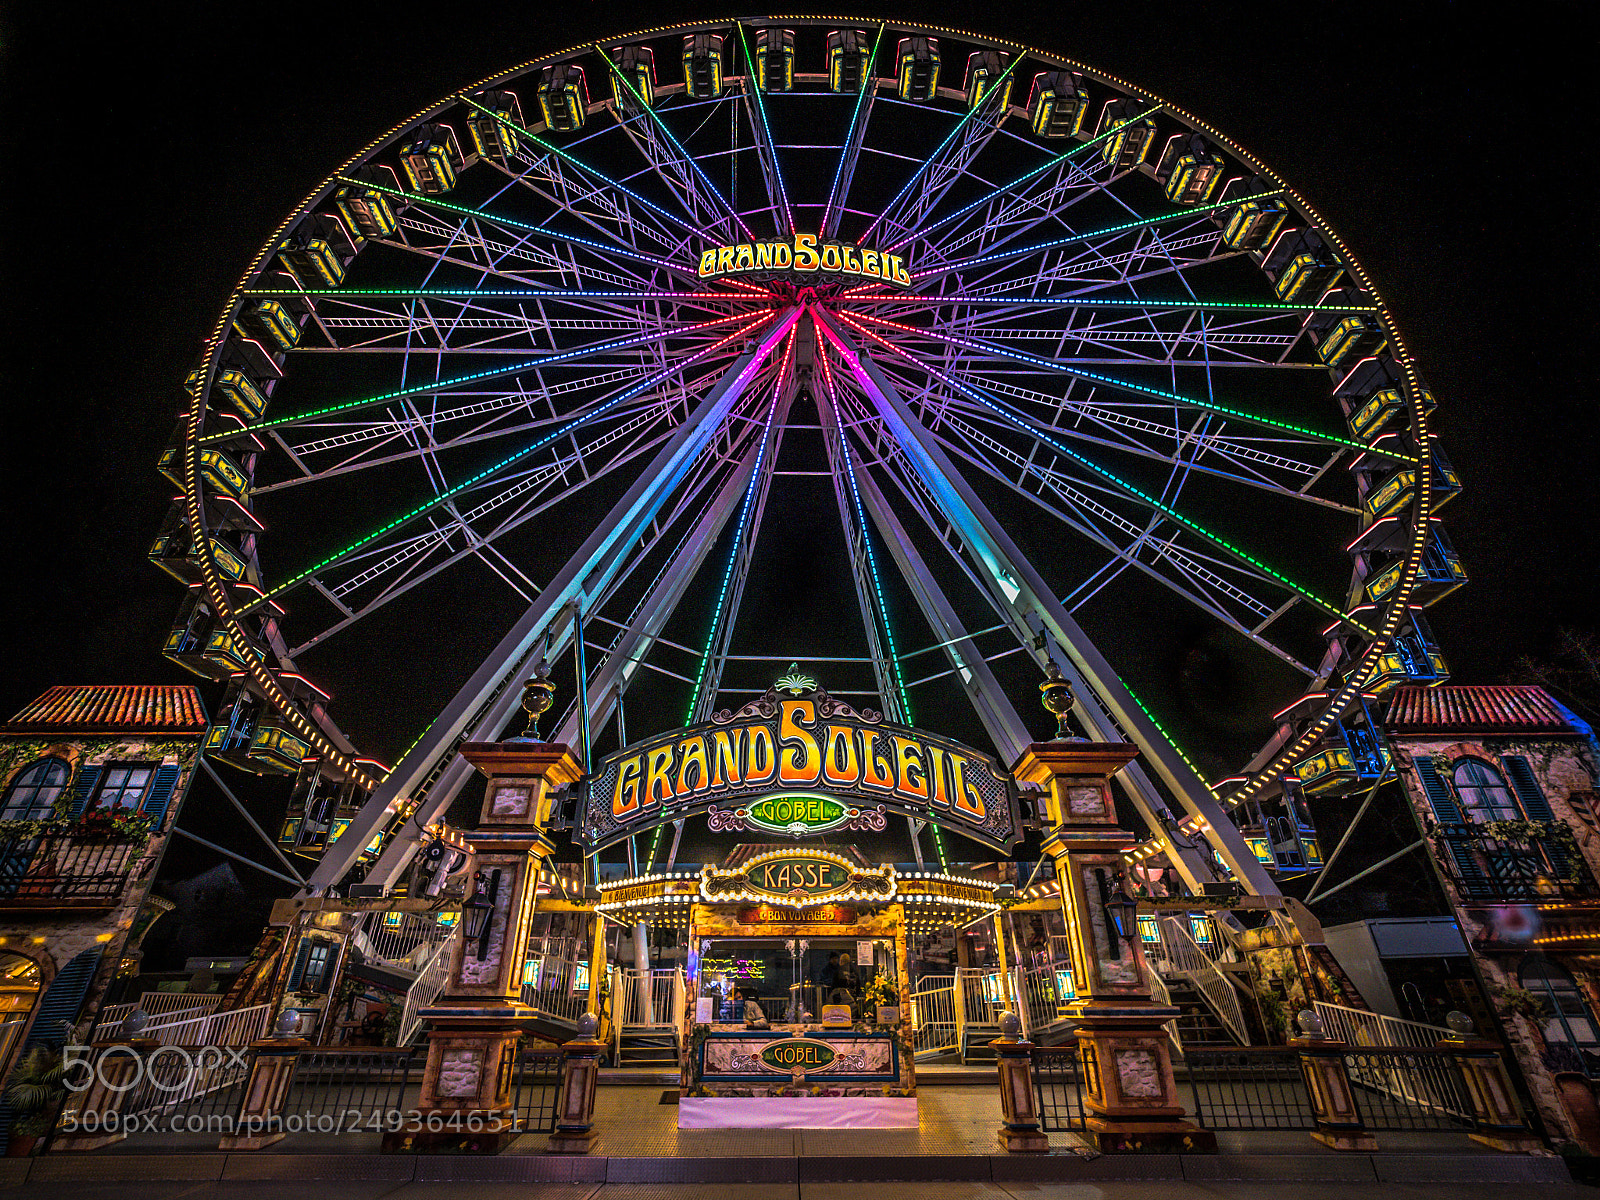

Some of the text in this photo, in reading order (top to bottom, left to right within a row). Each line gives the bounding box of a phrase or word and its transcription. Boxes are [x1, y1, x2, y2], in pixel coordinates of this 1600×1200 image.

[761, 797, 831, 822] GÖBEL
[764, 864, 832, 888] KASSE
[768, 910, 827, 921] BON VOYAGE
[774, 1044, 822, 1064] GÖBEL
